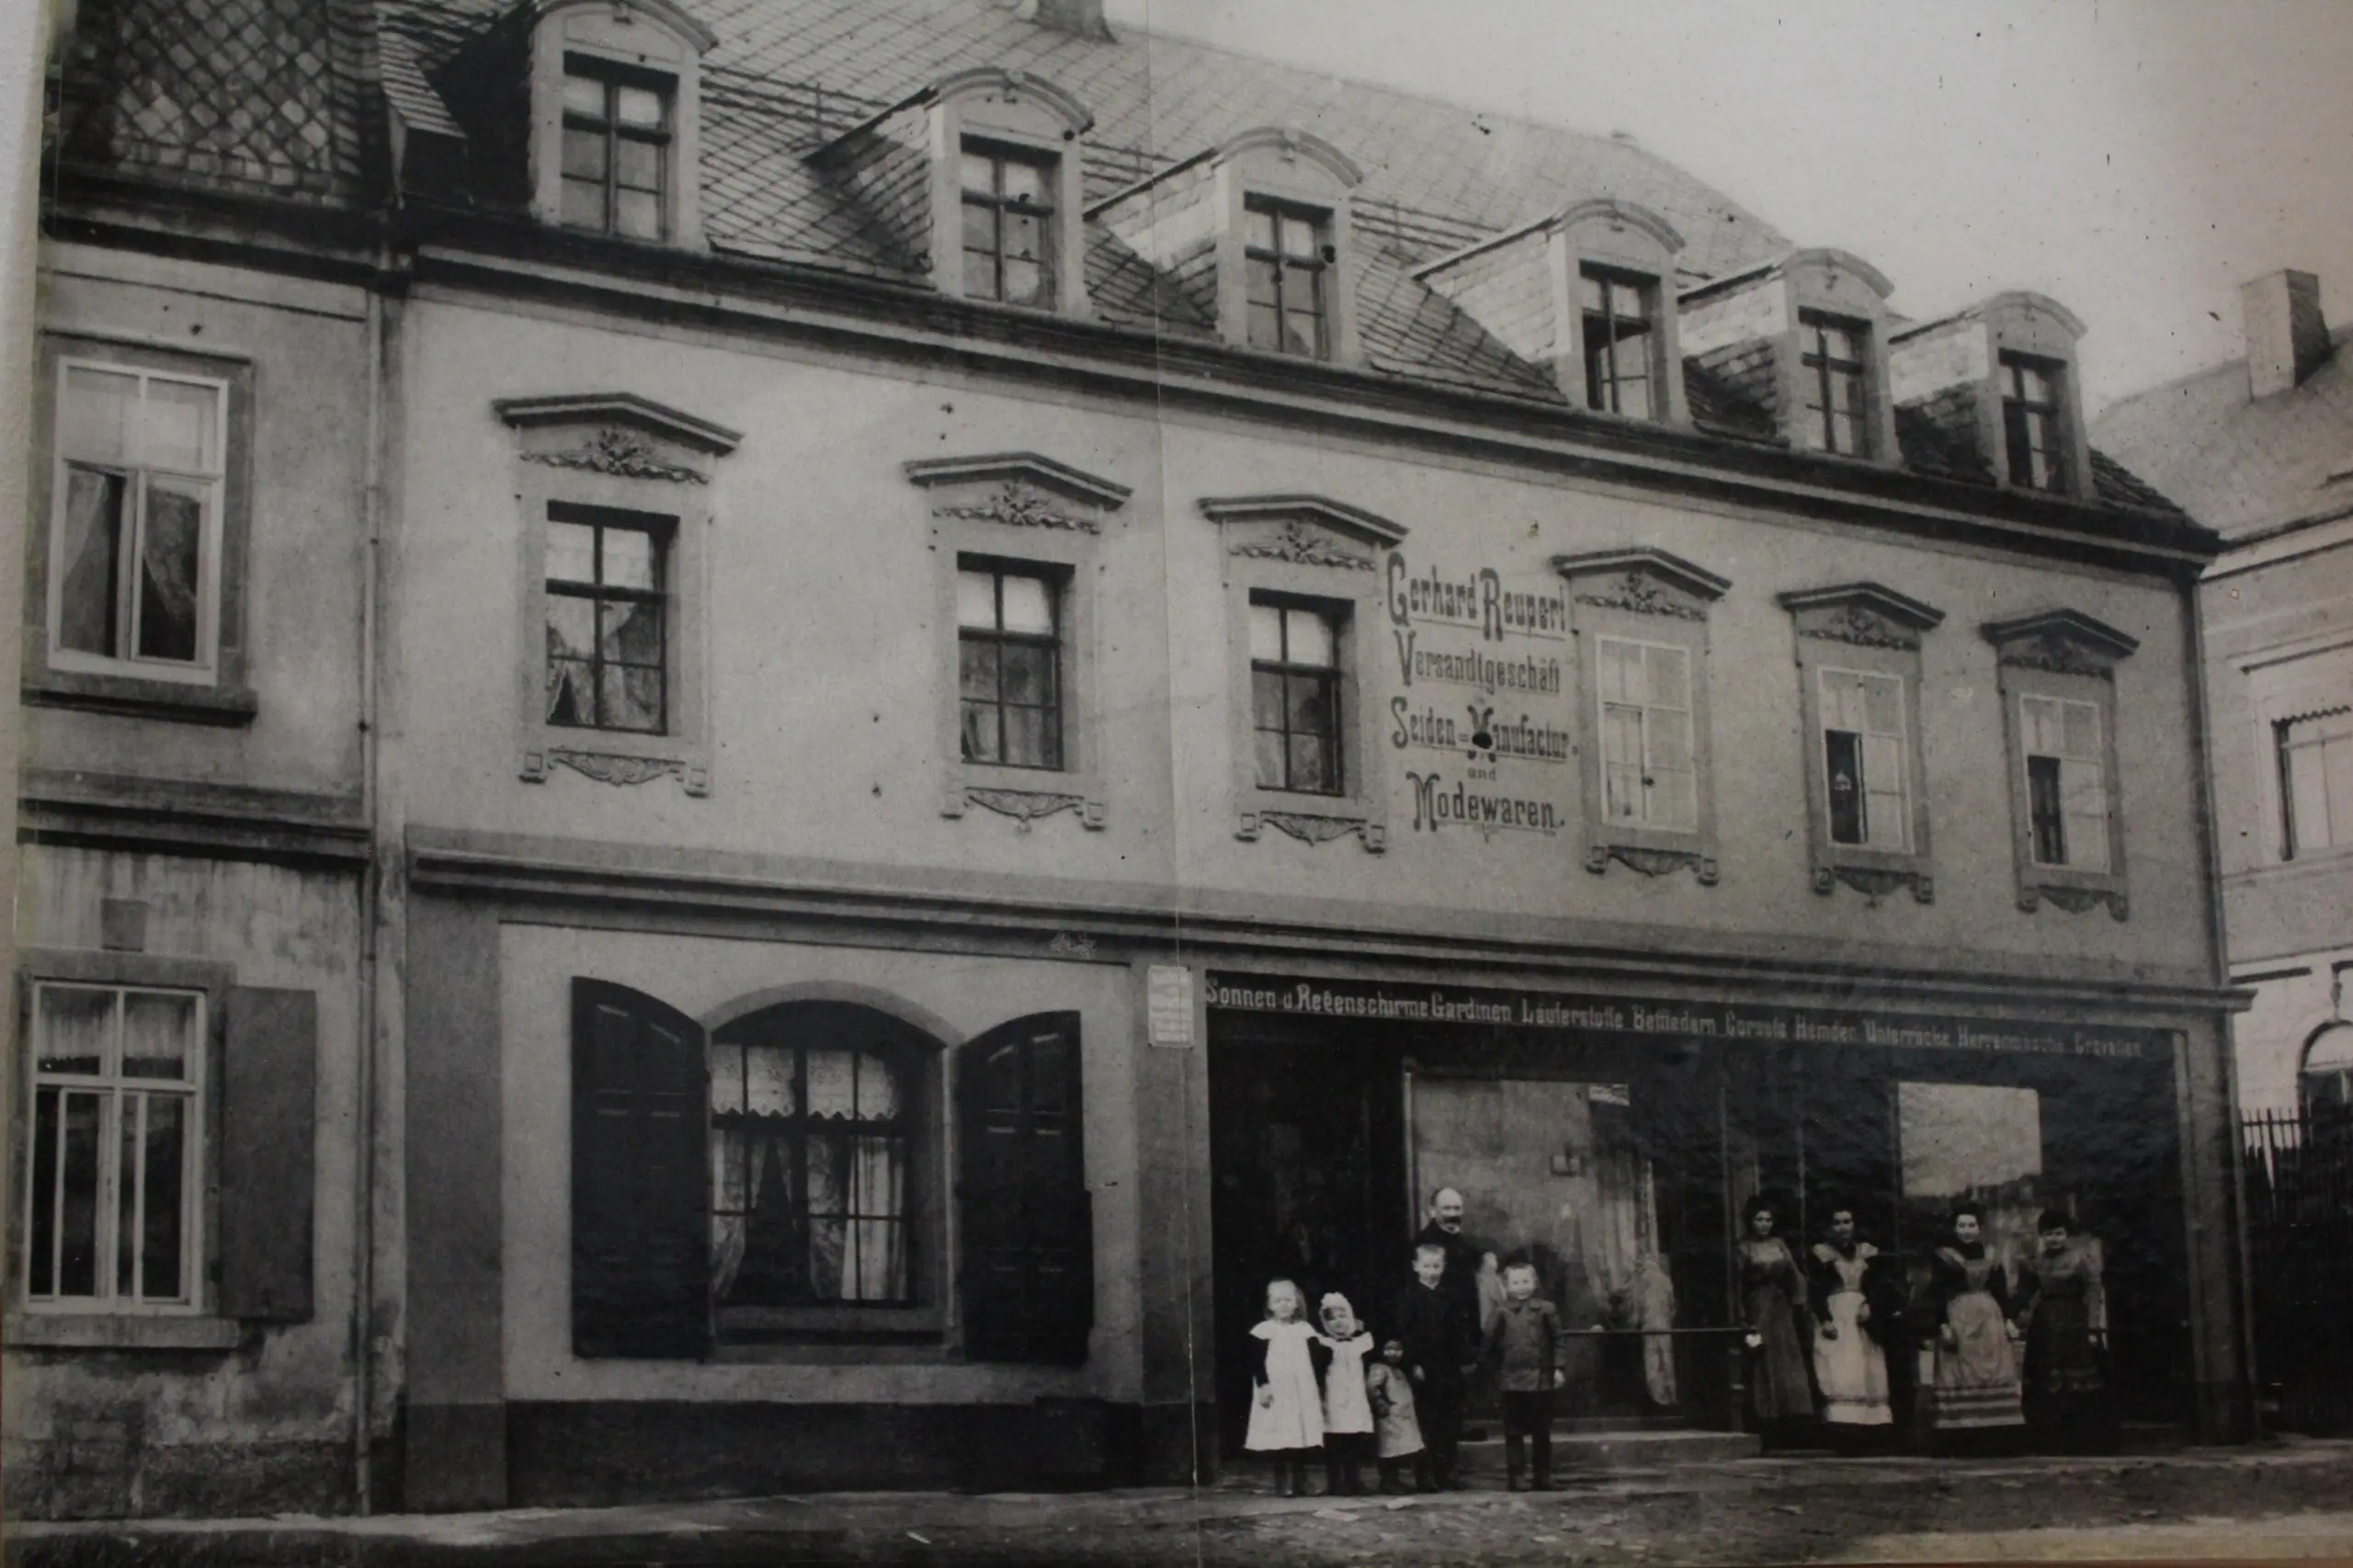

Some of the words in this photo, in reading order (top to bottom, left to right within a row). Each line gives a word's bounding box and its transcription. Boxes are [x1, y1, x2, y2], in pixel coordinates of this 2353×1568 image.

[1387, 551, 1477, 626] Gerhard
[1392, 630, 1560, 695] Versandtgeschäft
[1405, 771, 1566, 832] Modewaren.
[1468, 767, 1495, 780] und
[1203, 977, 1277, 1008] Sonnen
[1296, 983, 1428, 1018] Regenschirme
[1431, 991, 1513, 1023] Gardinen
